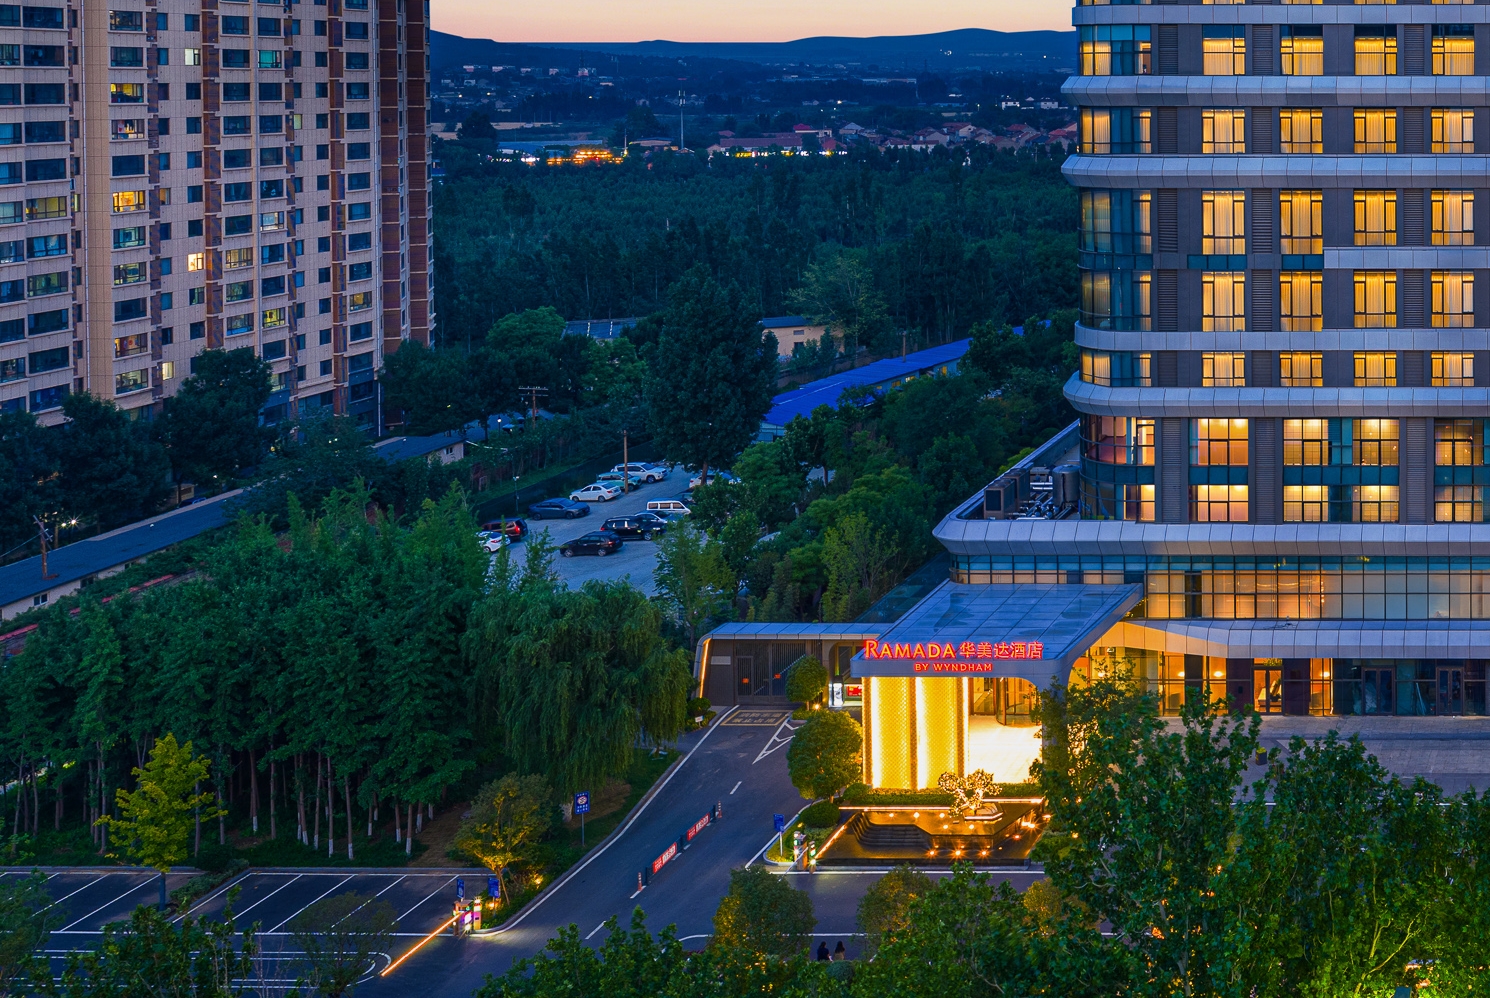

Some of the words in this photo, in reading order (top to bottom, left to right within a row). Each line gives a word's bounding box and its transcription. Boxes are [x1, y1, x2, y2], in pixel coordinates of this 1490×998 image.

[865, 640, 956, 659] RAMADA
[959, 642, 1043, 659] 华美达酒店
[915, 663, 928, 671] BY
[933, 663, 992, 671] WYNDHAM
